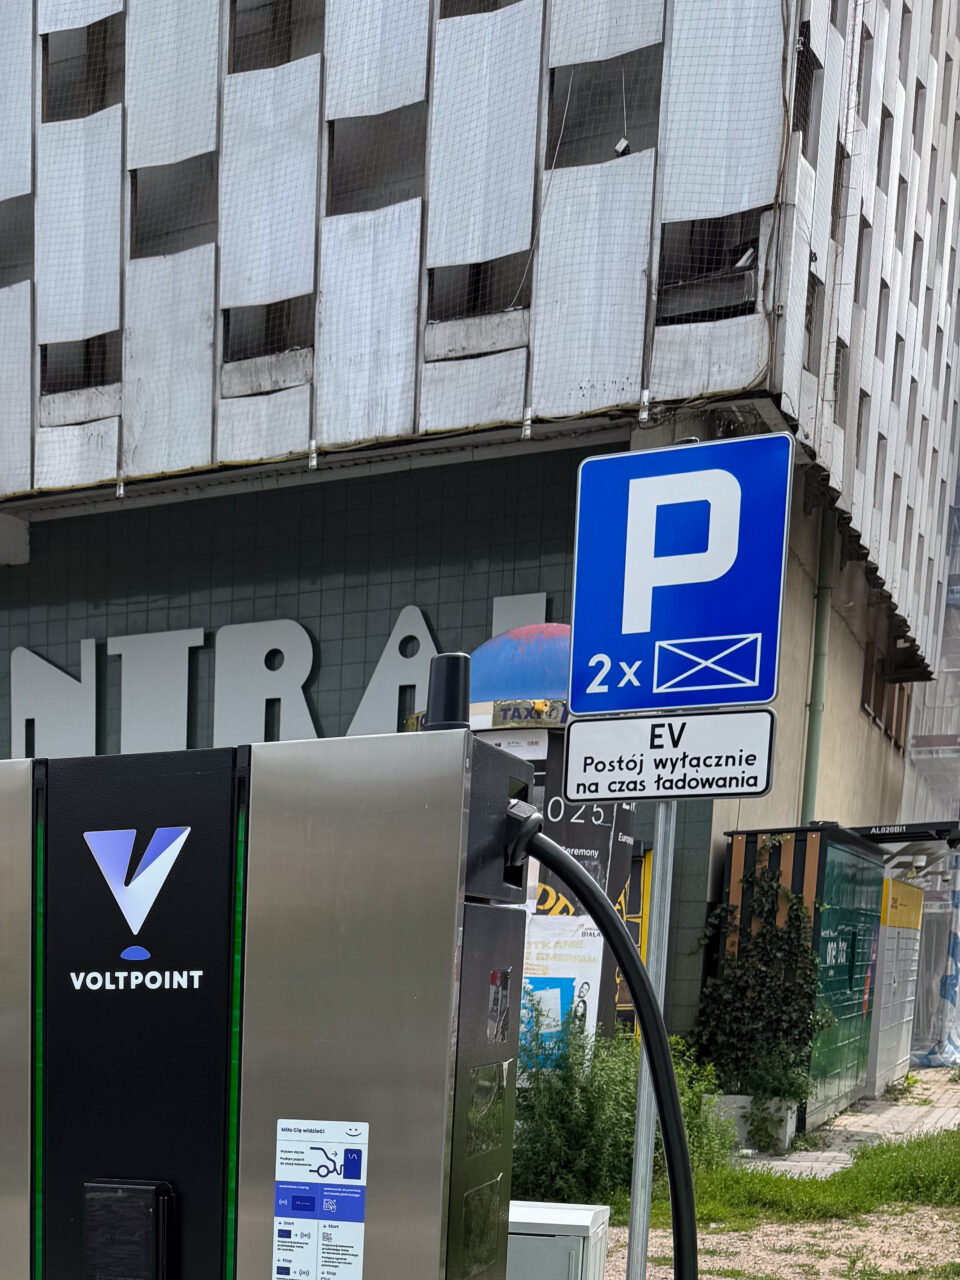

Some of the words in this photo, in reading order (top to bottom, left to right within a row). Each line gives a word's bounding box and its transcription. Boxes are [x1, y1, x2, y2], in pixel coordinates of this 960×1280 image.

[622, 469, 741, 634] P
[649, 722, 687, 750] EV
[583, 753, 644, 775] Postój
[654, 749, 757, 774] wyłącznie
[576, 781, 599, 795] na
[607, 778, 646, 793] czas
[654, 771, 758, 791] ładowania
[547, 796, 604, 824] 025
[70, 970, 203, 990] VOLTPOINT
